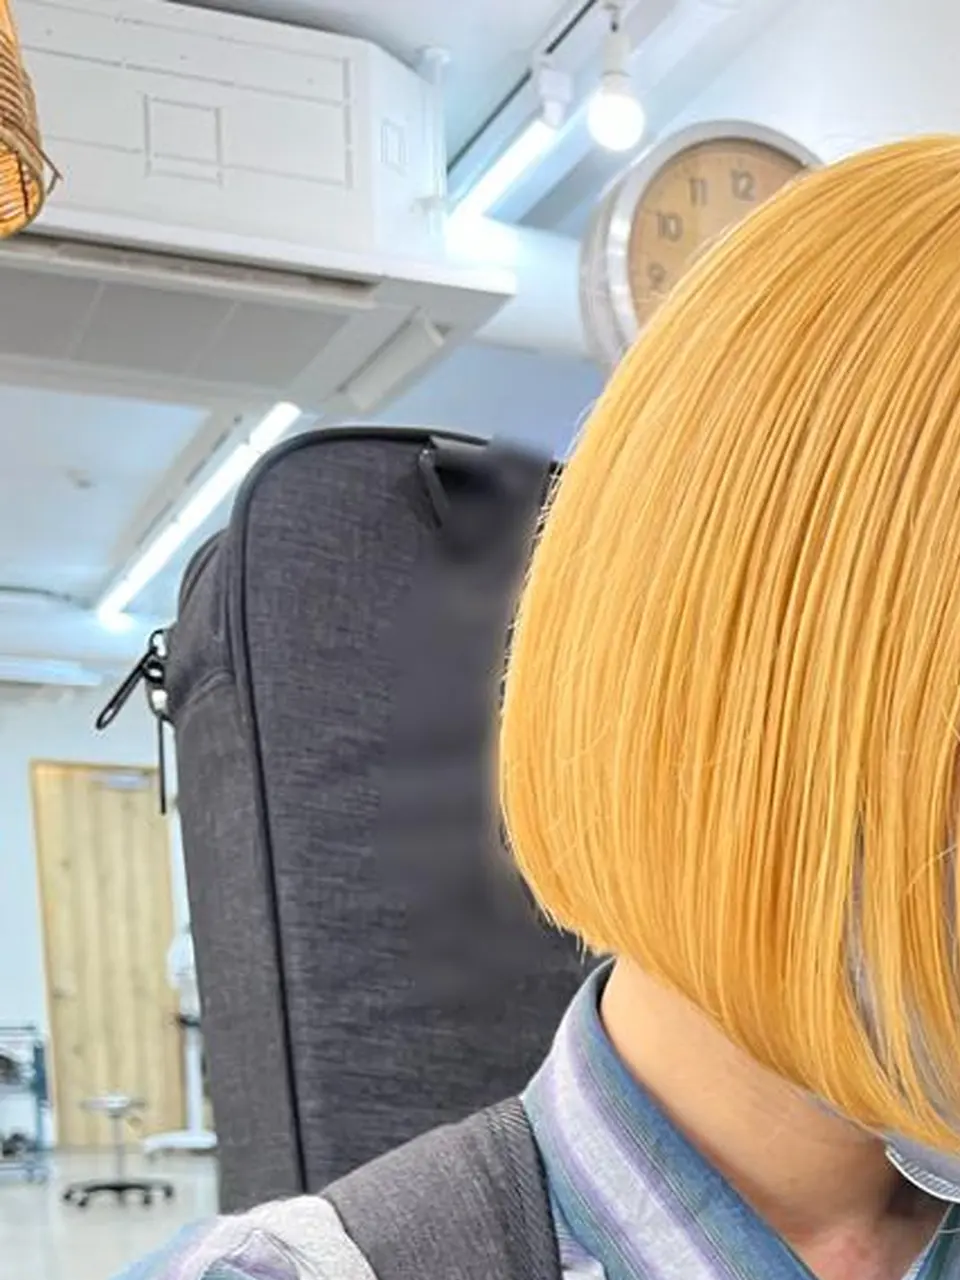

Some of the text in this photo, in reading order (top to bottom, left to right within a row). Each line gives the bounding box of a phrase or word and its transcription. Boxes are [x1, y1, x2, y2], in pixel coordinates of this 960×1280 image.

[689, 176, 709, 207] 11
[732, 168, 756, 201] 12
[656, 210, 684, 241] 10
[648, 263, 666, 289] 9
